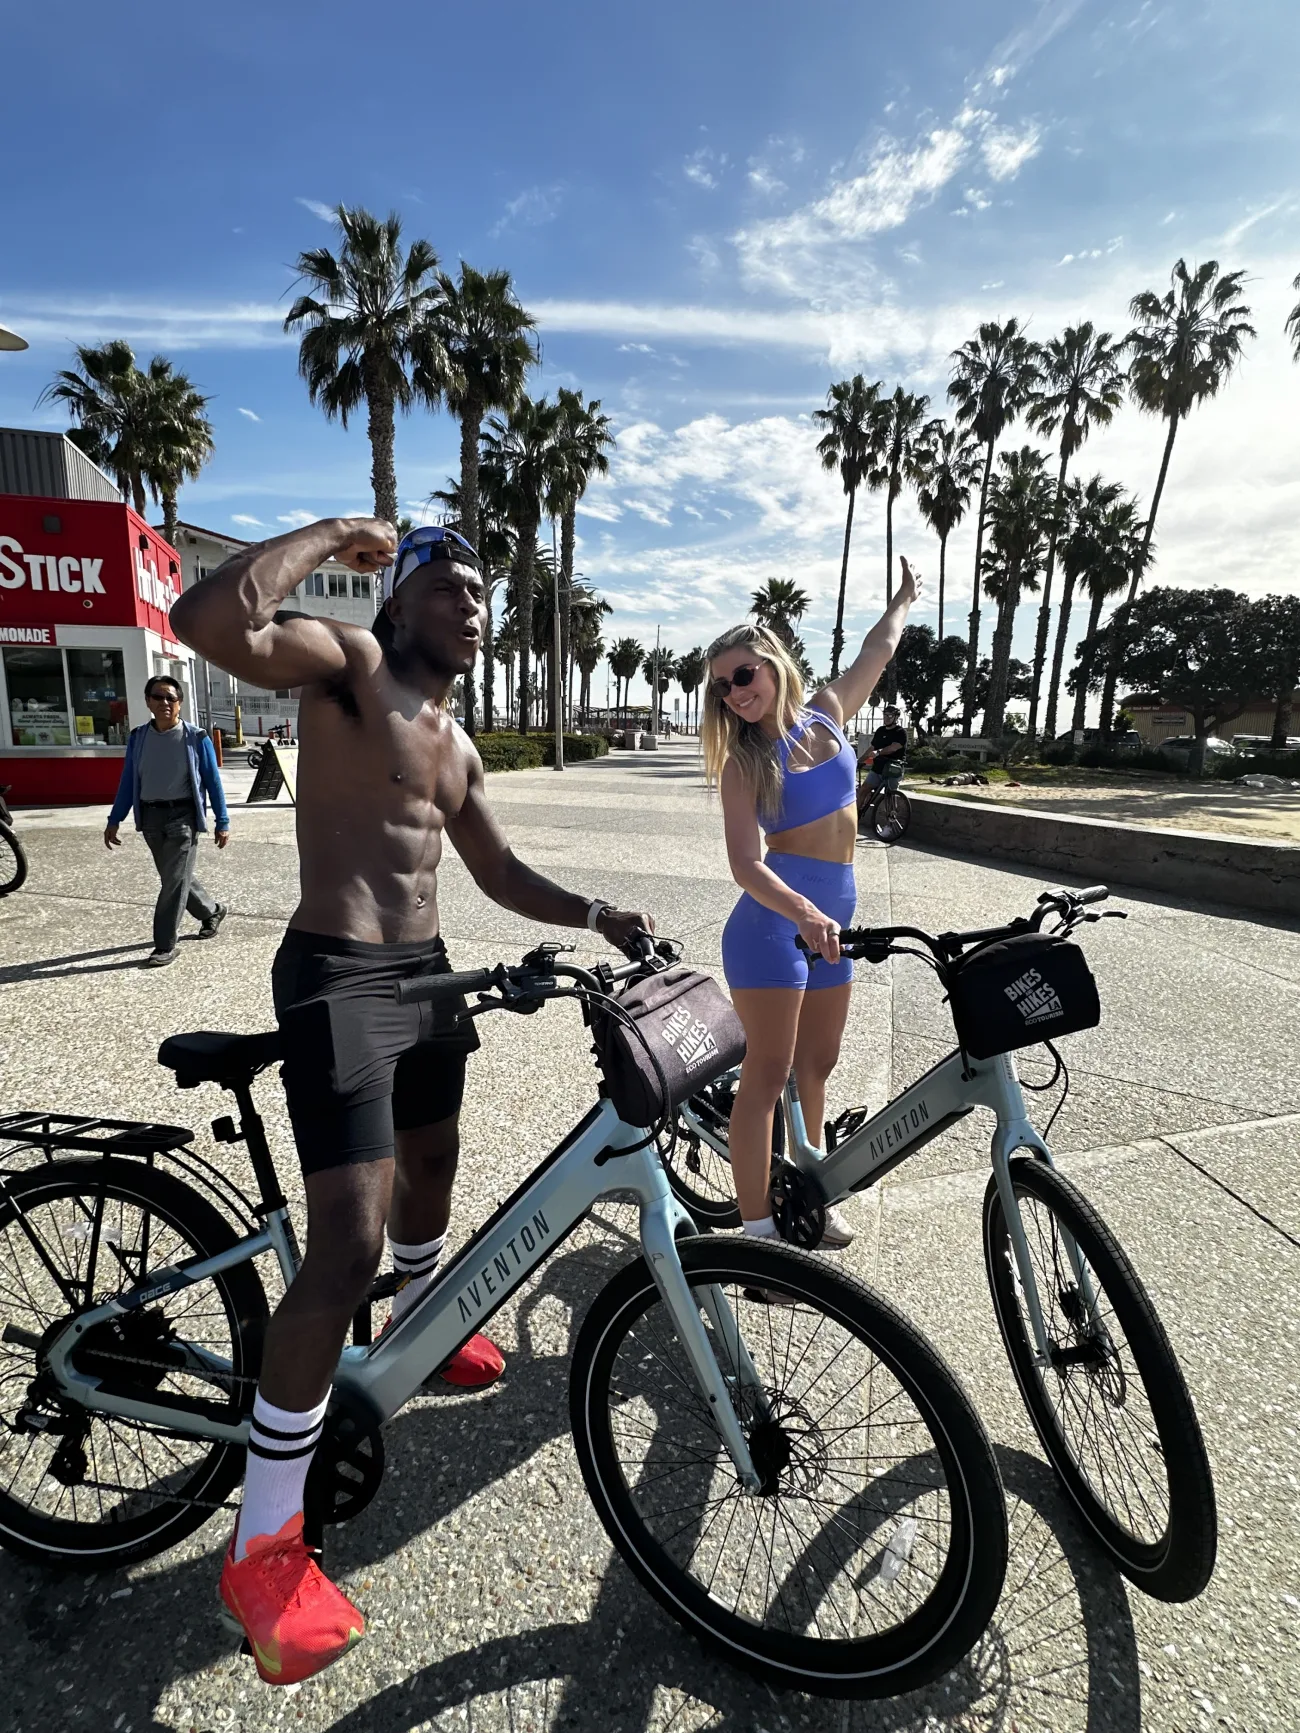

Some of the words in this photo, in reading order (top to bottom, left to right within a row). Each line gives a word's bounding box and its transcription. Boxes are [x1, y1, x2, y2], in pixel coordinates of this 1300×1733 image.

[0, 536, 107, 594] STICK
[1004, 968, 1042, 1002] BIKES
[1016, 982, 1056, 1017] HIKES
[661, 1005, 692, 1047] BIKES
[676, 1018, 708, 1064] HIKES
[869, 1100, 930, 1161] AVENTON
[457, 1209, 550, 1324] AVENTON
